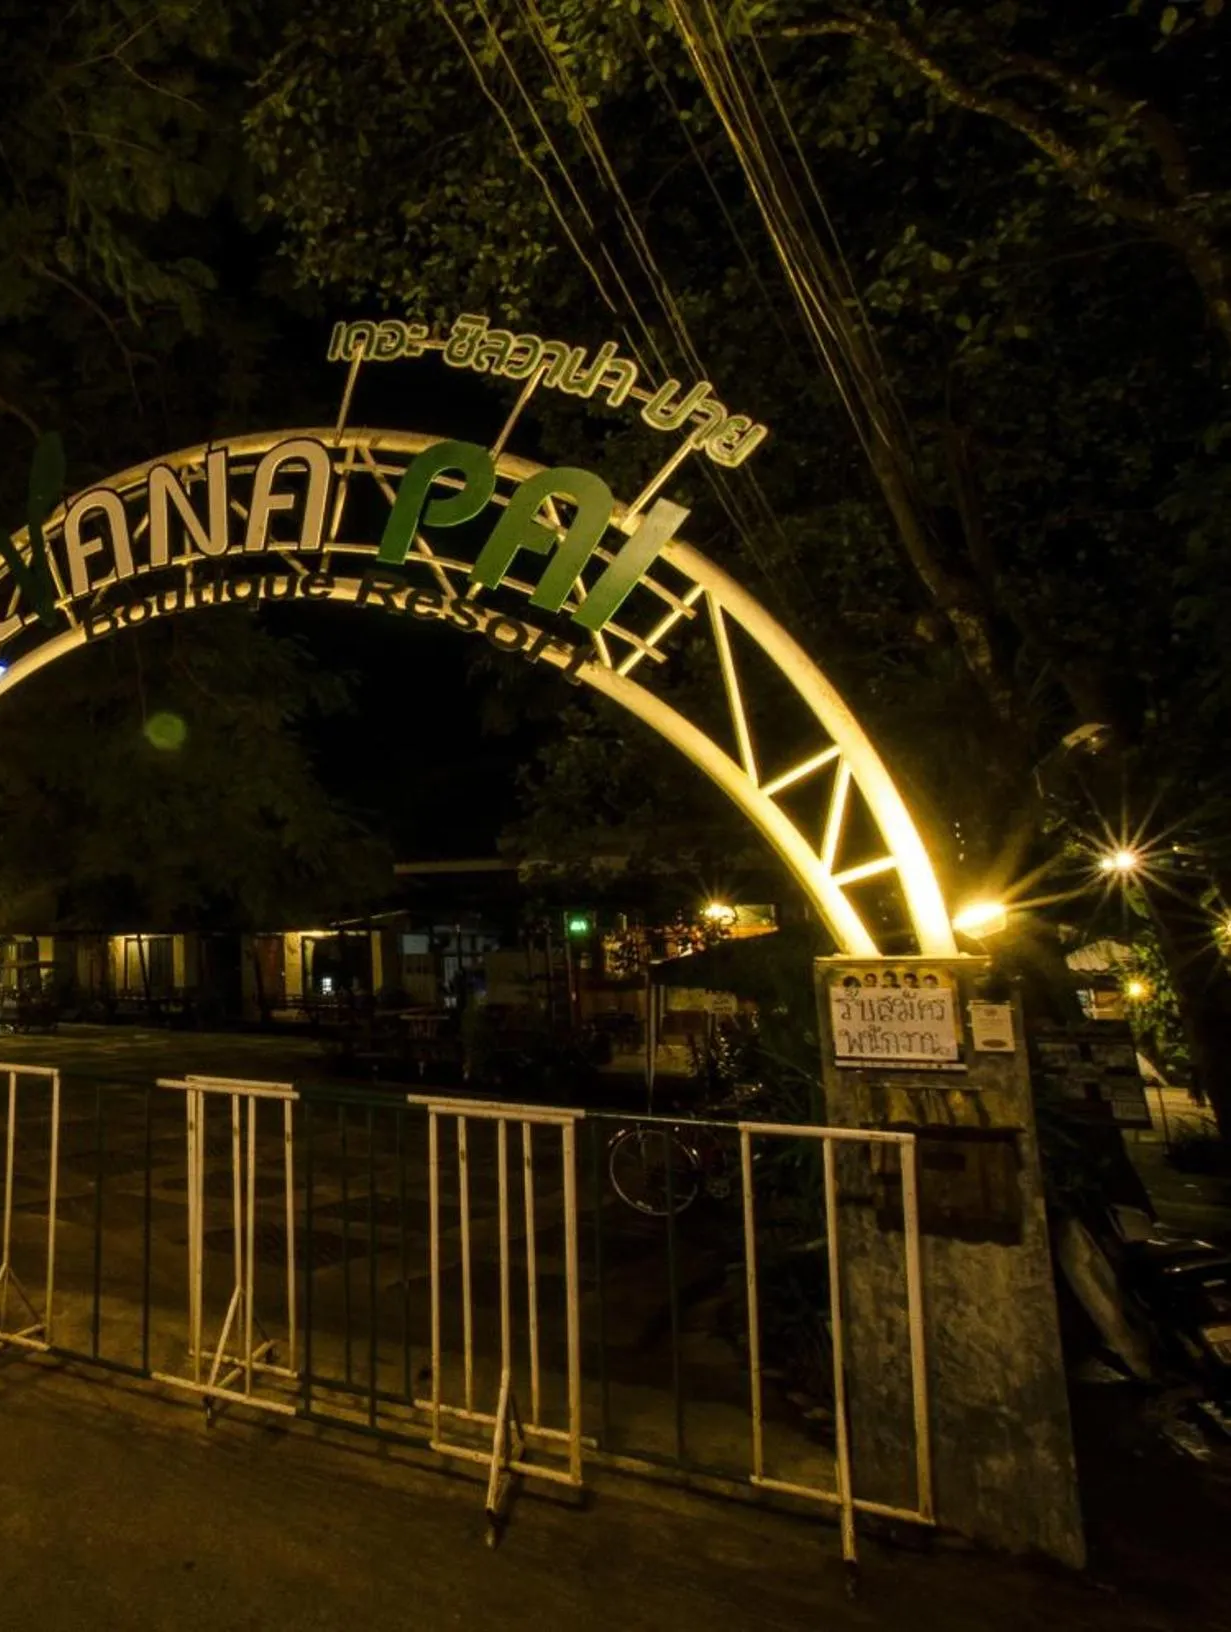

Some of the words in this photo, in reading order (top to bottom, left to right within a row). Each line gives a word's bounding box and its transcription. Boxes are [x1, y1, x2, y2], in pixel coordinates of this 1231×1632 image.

[641, 378, 768, 469] ปาย
[375, 439, 692, 632] PAI
[82, 570, 336, 642] Boutique
[354, 572, 598, 686] Resort
